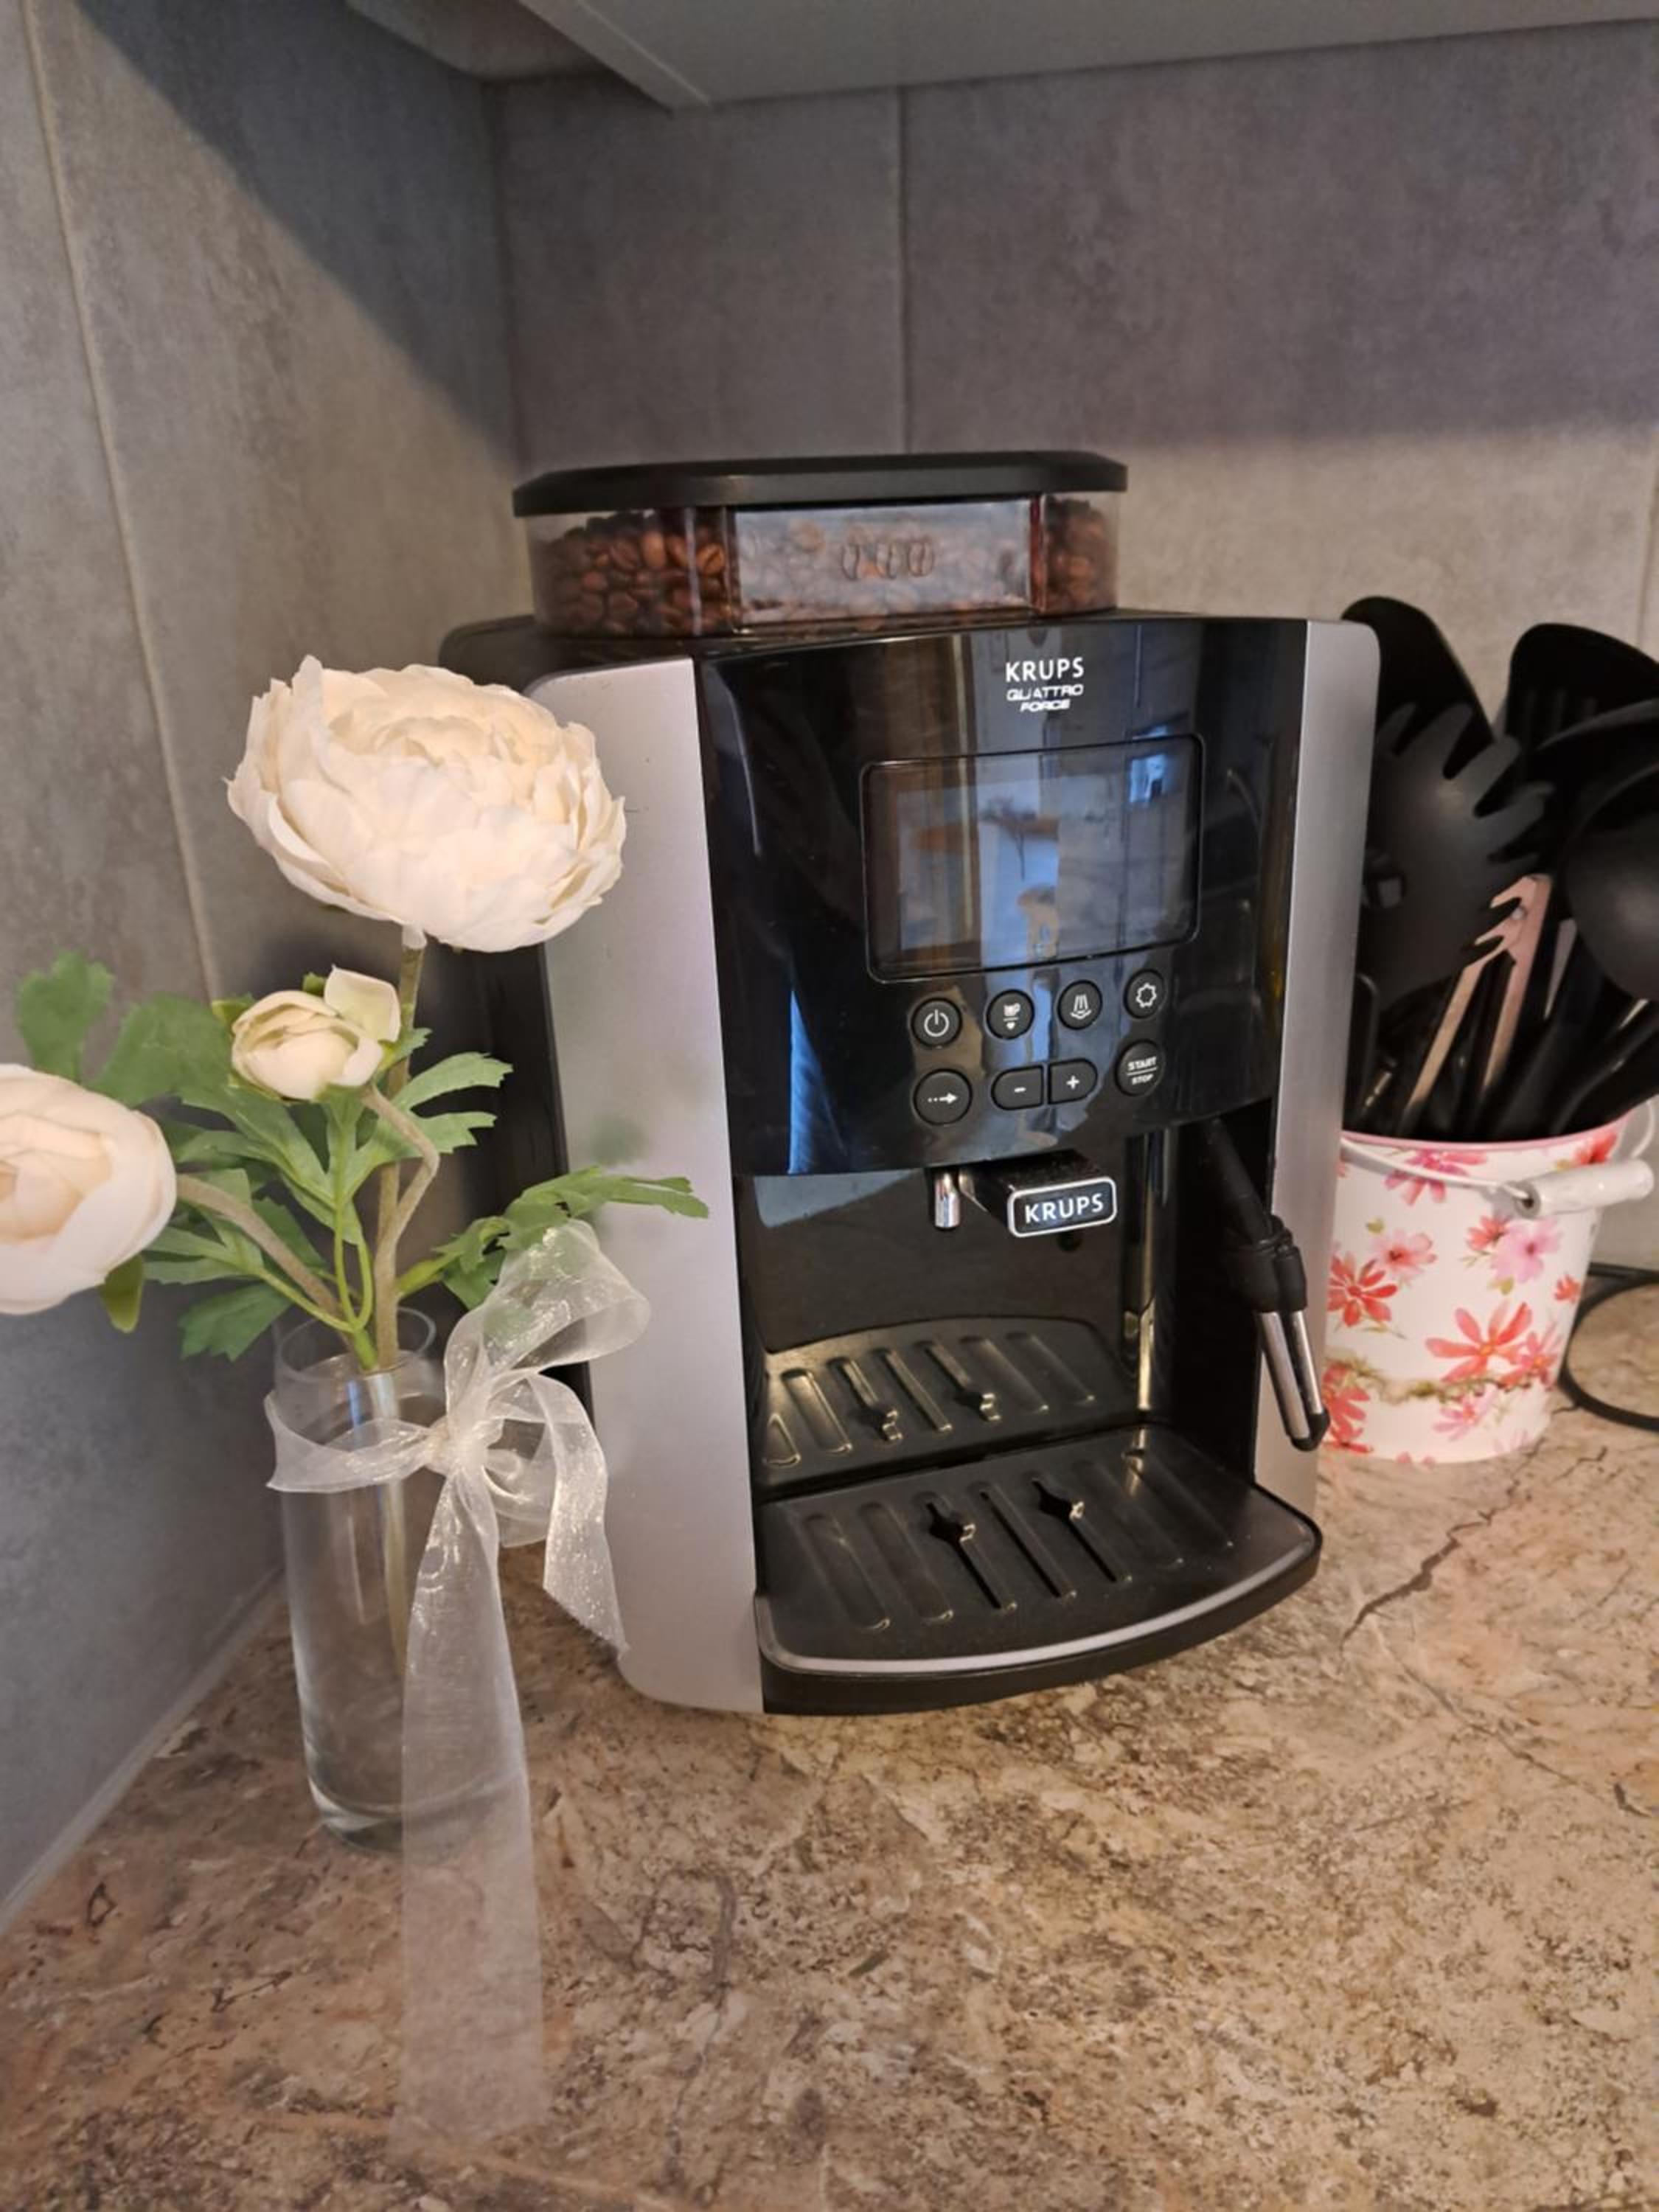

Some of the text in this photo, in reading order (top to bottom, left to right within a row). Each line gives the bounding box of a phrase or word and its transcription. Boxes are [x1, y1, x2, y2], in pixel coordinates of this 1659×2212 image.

[1005, 657, 1084, 683] KRUPS
[1006, 684, 1084, 701] QUATTRO
[1020, 698, 1071, 712] FORCE
[1127, 1056, 1157, 1071] START
[1132, 1074, 1153, 1085] STOP
[1024, 1193, 1104, 1224] KRUPS
